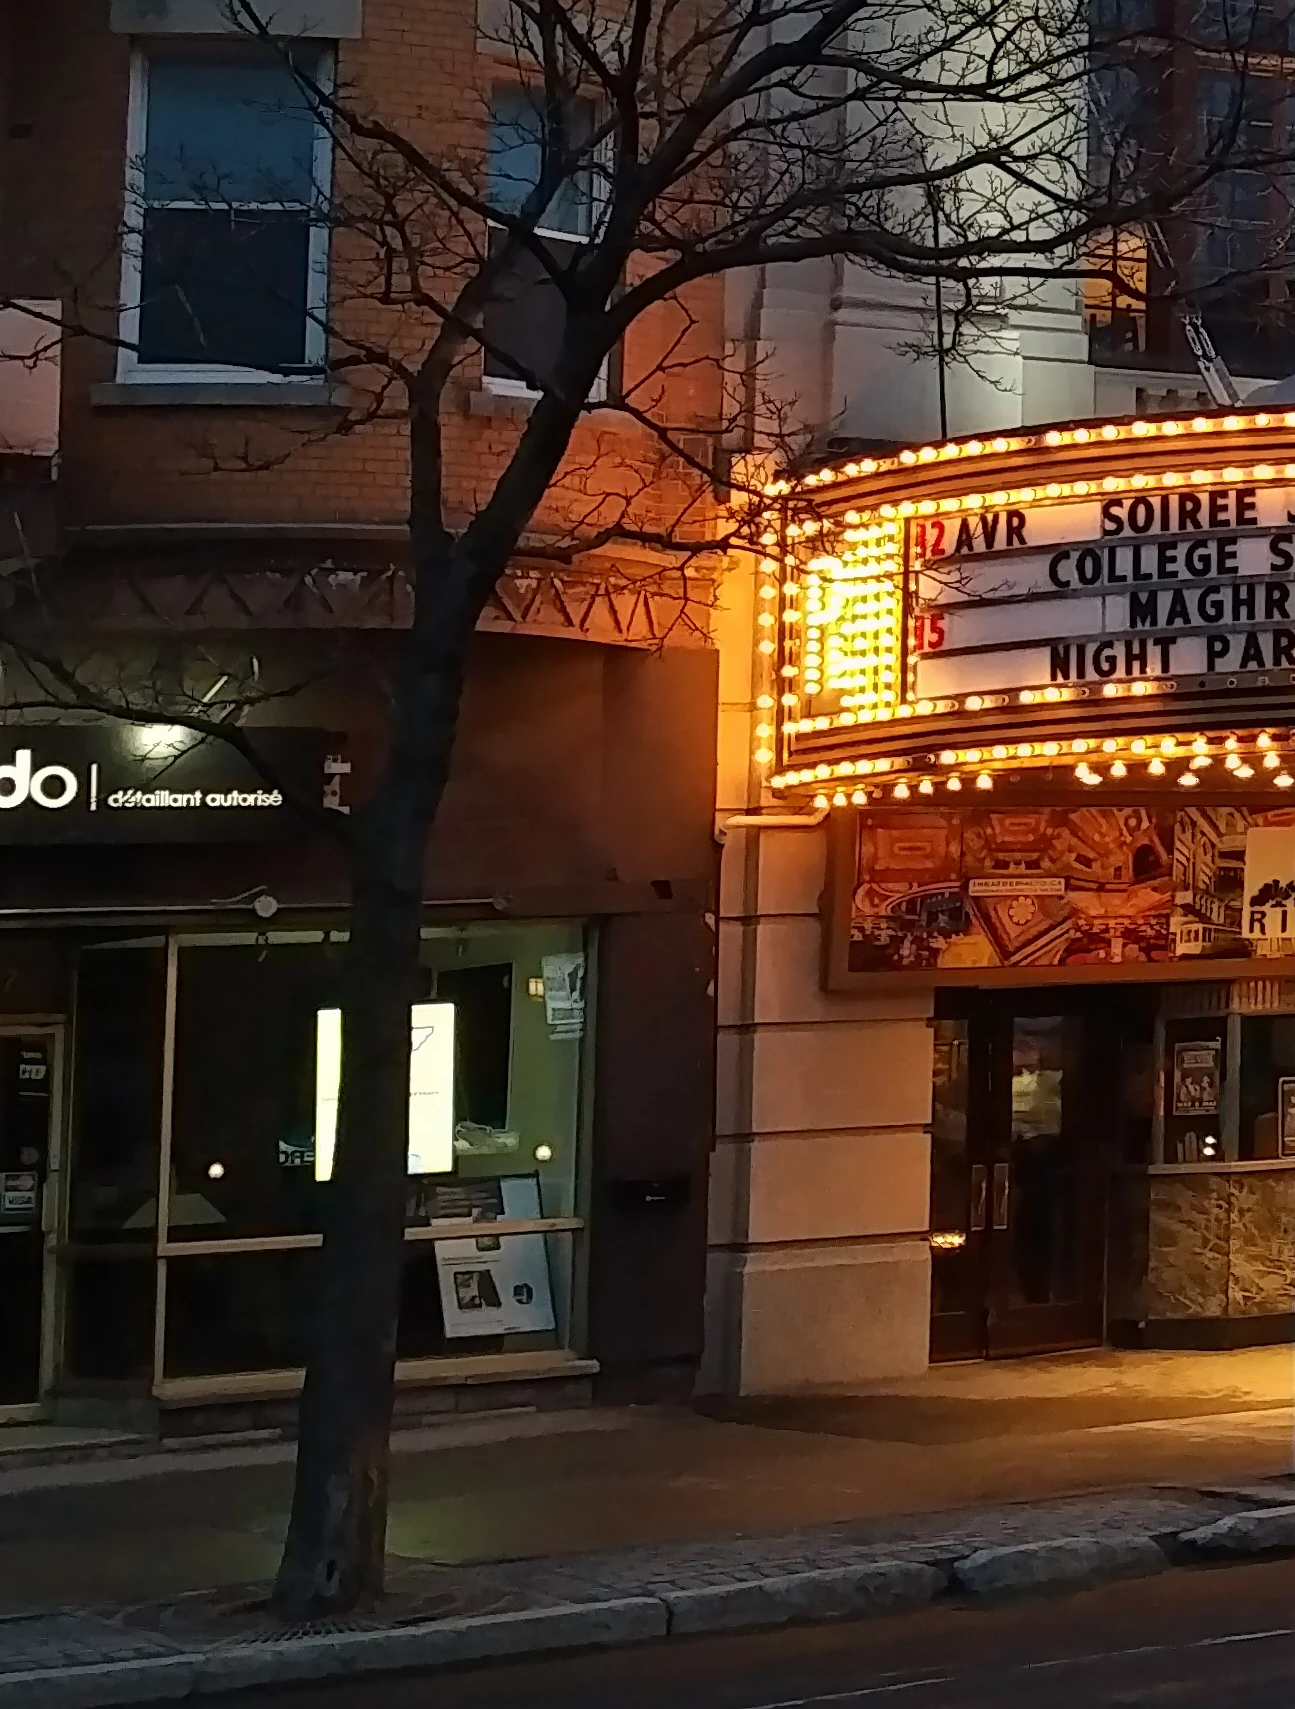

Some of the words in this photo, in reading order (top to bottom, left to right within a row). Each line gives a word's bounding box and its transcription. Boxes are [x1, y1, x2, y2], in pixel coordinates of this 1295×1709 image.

[916, 521, 945, 559] 12
[954, 509, 1028, 554] AVR
[1103, 489, 1258, 536] SOIREE
[1049, 537, 1239, 588] COLLEGE
[915, 611, 945, 650] 15
[1050, 636, 1177, 681] NIGHT
[107, 787, 201, 808] détaillant
[205, 789, 283, 808] autorisé
